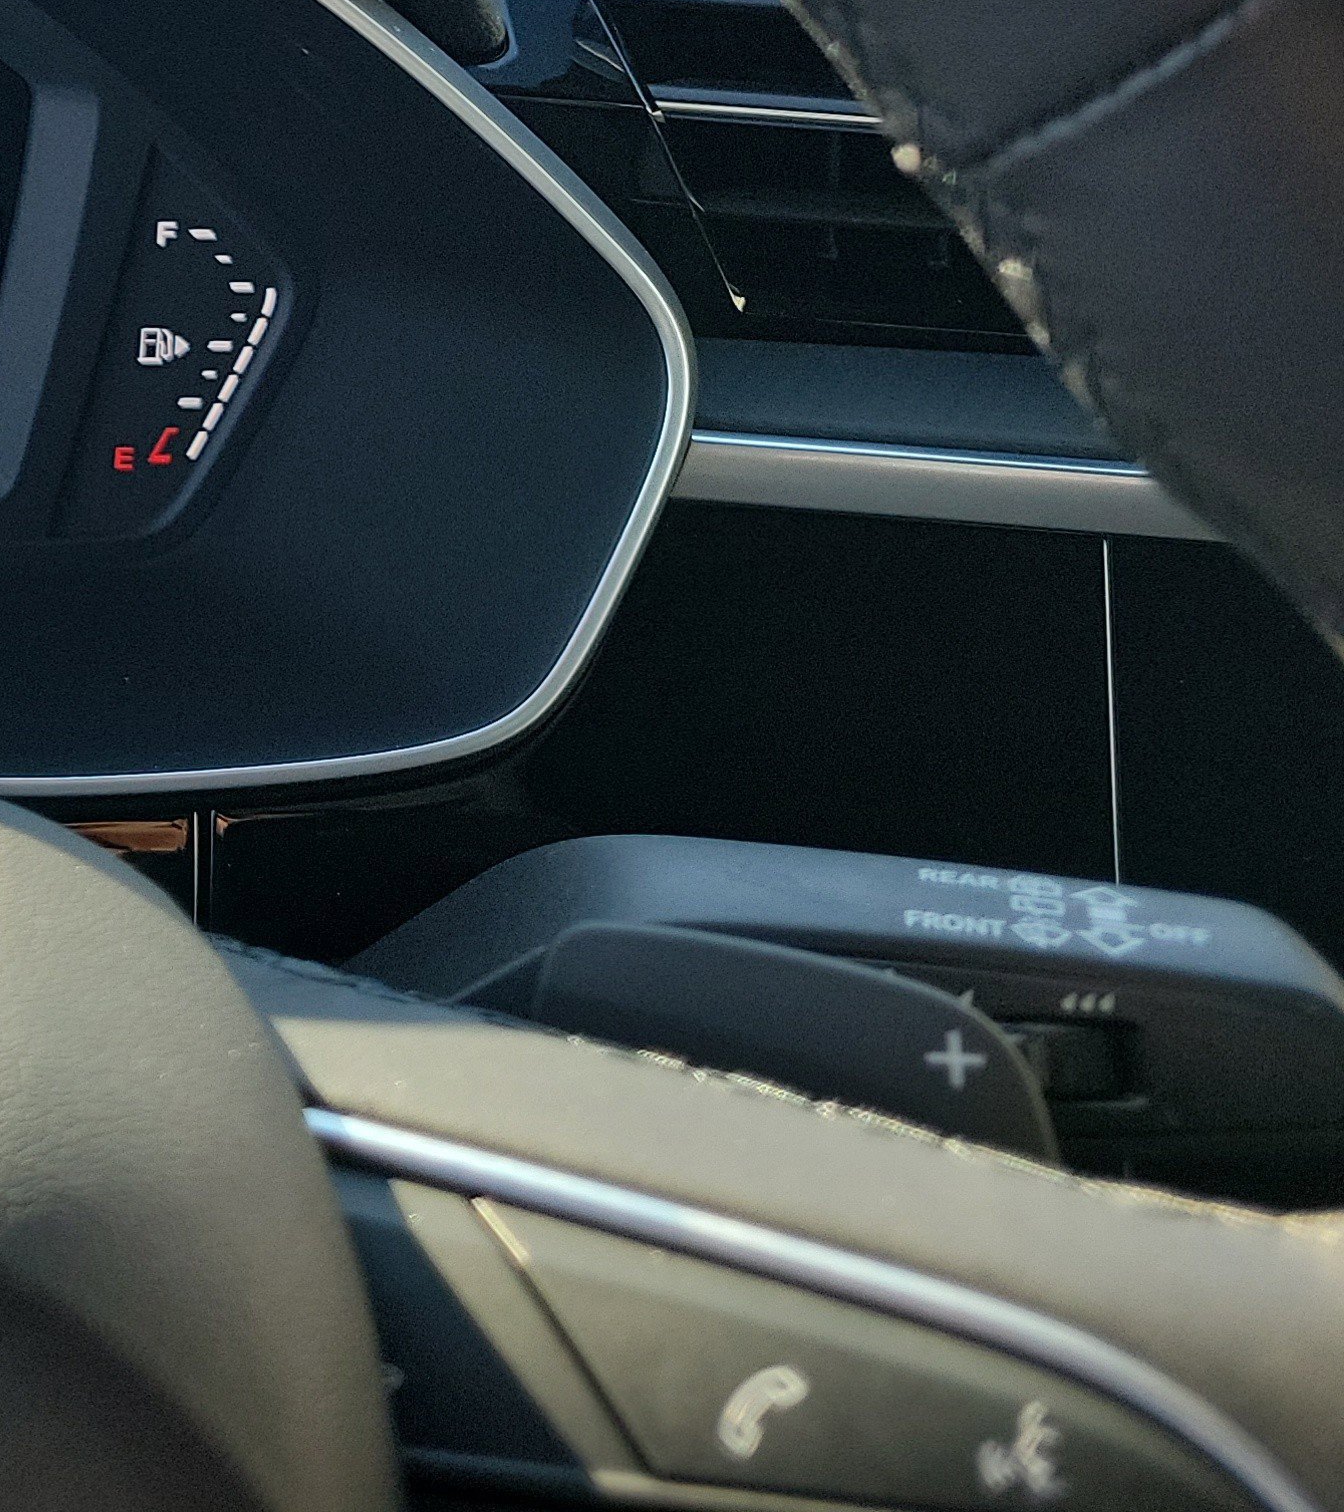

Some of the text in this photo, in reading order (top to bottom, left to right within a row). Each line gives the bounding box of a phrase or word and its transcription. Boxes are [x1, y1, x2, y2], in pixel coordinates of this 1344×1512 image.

[156, 221, 178, 247] F
[114, 446, 135, 470] E
[917, 867, 1000, 889] REAR
[903, 909, 1007, 938] FRONT
[1148, 922, 1210, 947] OFF
